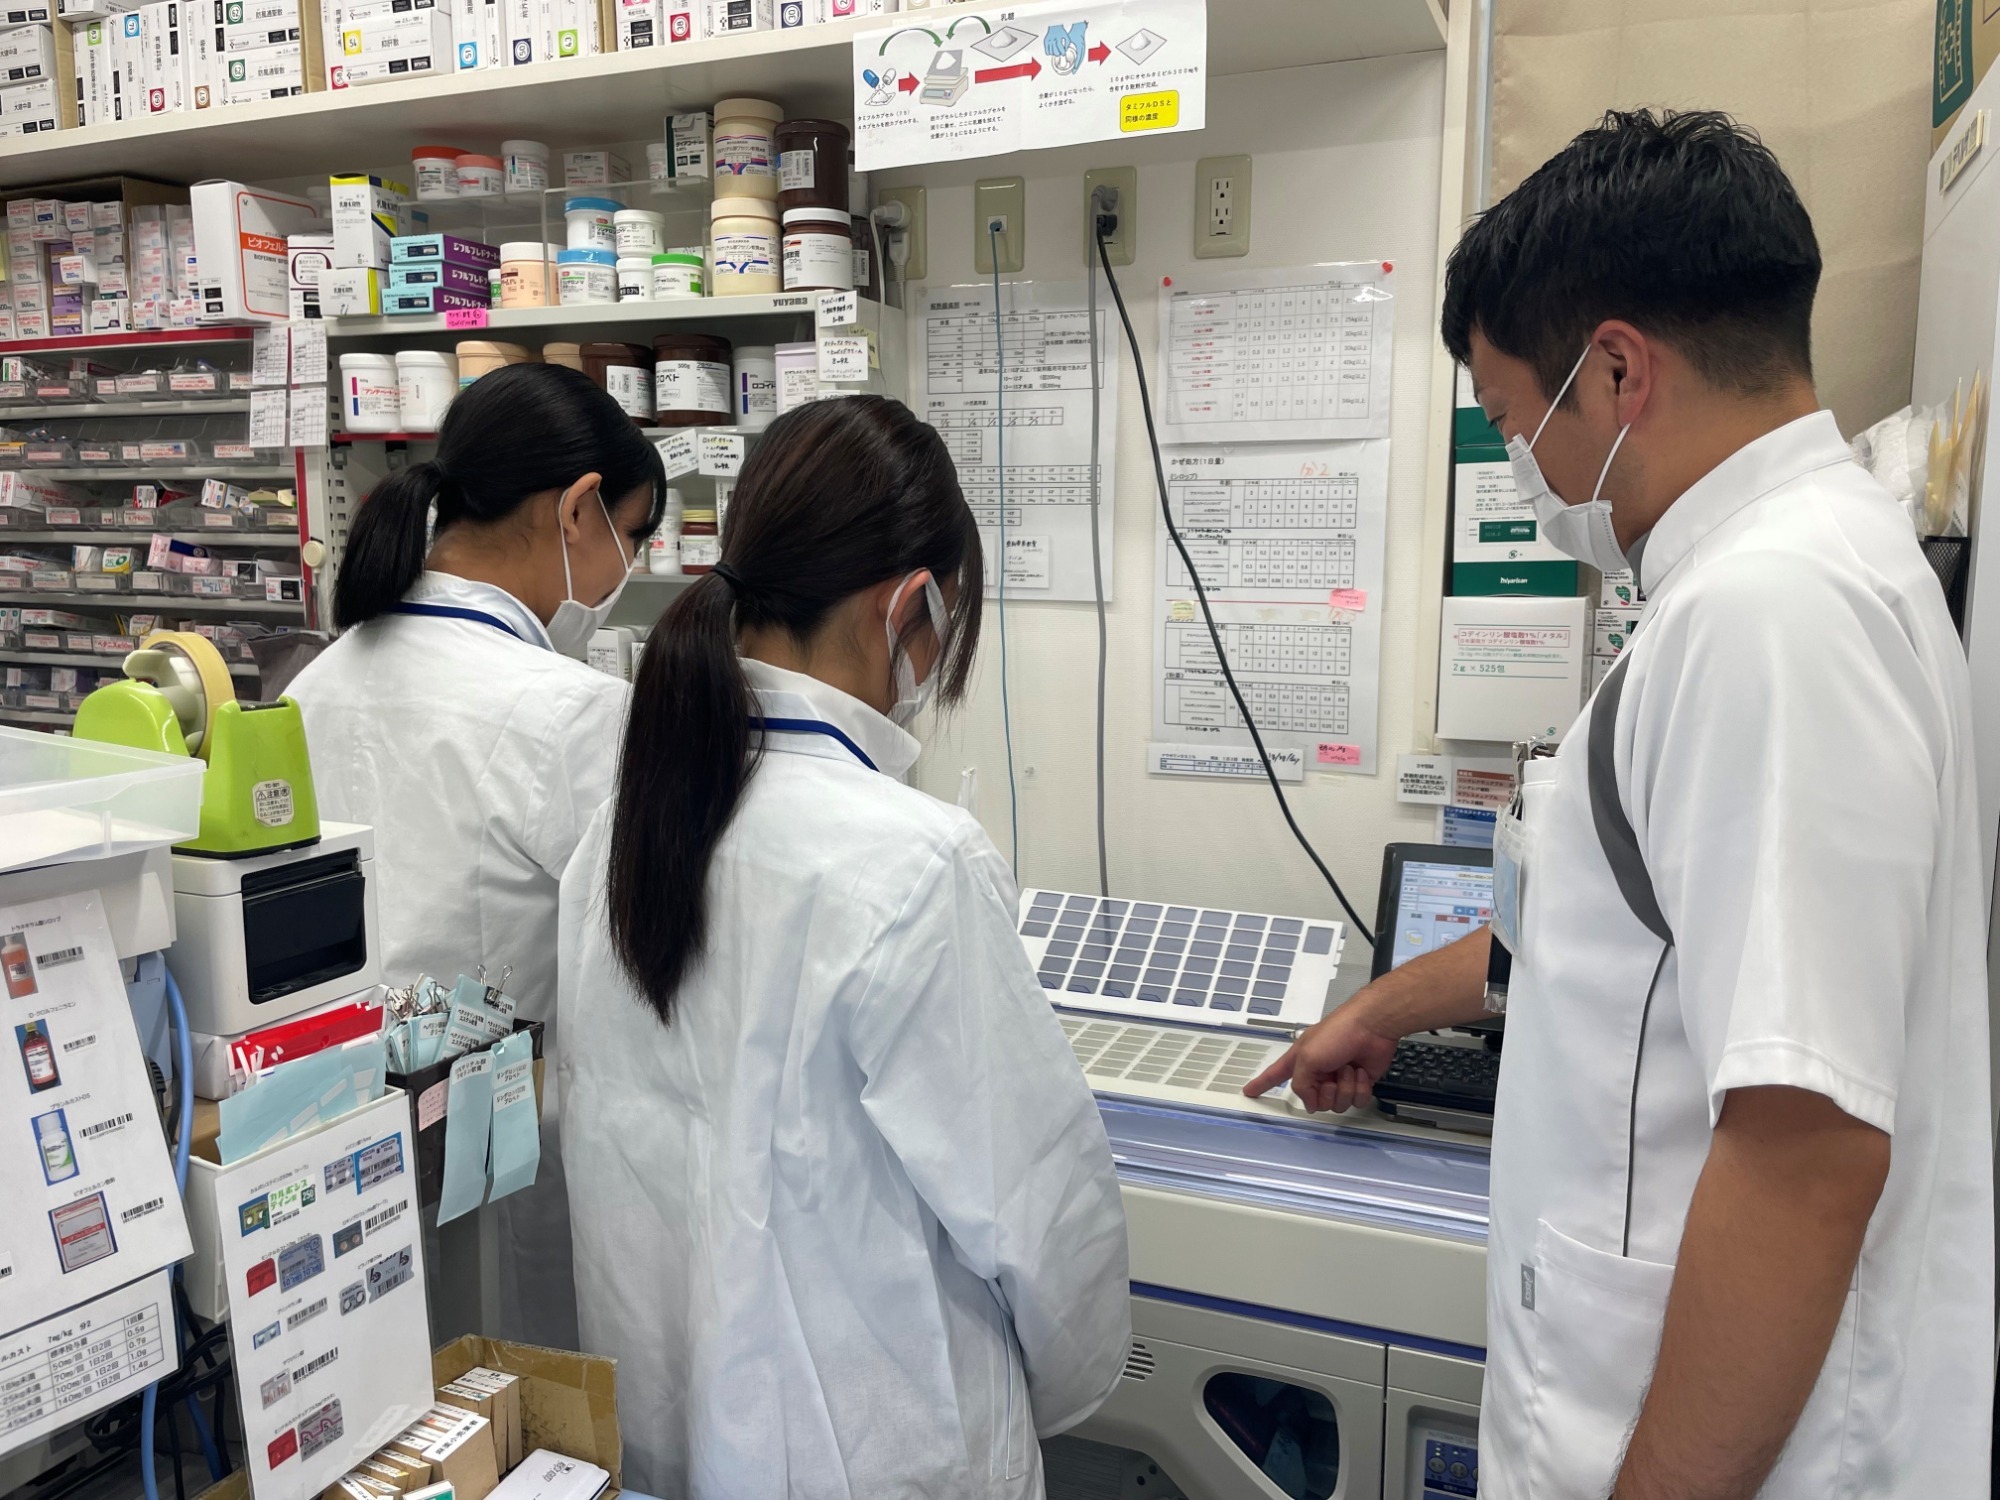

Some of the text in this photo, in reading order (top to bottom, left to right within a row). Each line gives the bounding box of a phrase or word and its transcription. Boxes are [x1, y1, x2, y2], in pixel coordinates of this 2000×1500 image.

[789, 9, 795, 20] 30
[1000, 12, 1015, 22] 乳糖
[677, 21, 685, 32] 38
[349, 38, 357, 48] 54
[565, 37, 572, 47] 43
[465, 50, 472, 59] 51
[519, 46, 526, 56] 50
[234, 67, 241, 75] 62
[1125, 113, 1158, 124] 同様の濃度
[773, 297, 808, 307] yuyama
[1480, 665, 1505, 673] 525包
[267, 790, 280, 798] 注意
[303, 1190, 314, 1201] 250
[87, 1339, 111, 1354] 1日2回
[128, 1325, 144, 1337] 0.5g
[89, 1351, 113, 1366] 1日2回
[129, 1337, 146, 1349] 0.7g
[95, 1361, 119, 1376] 1日2回
[130, 1349, 147, 1360] 1.0g
[97, 1372, 120, 1388] 1日2回
[132, 1360, 148, 1372] 1.4g
